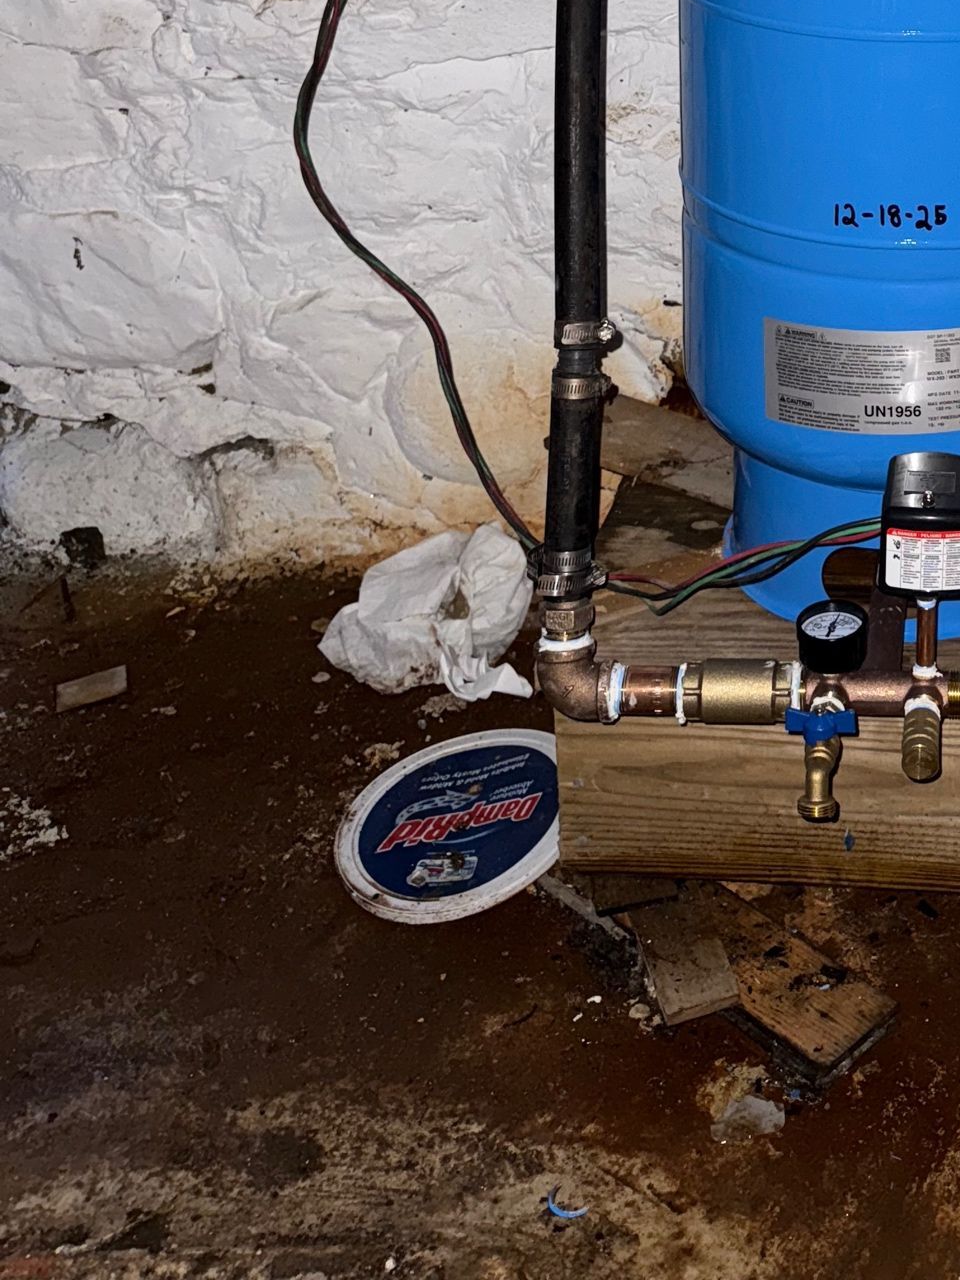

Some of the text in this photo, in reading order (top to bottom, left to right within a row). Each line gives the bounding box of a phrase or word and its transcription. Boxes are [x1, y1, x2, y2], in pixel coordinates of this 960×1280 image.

[834, 203, 948, 231] 12-18-25
[786, 397, 813, 408] CAUTION
[864, 405, 922, 418] UN1956
[374, 791, 543, 854] DampRid
